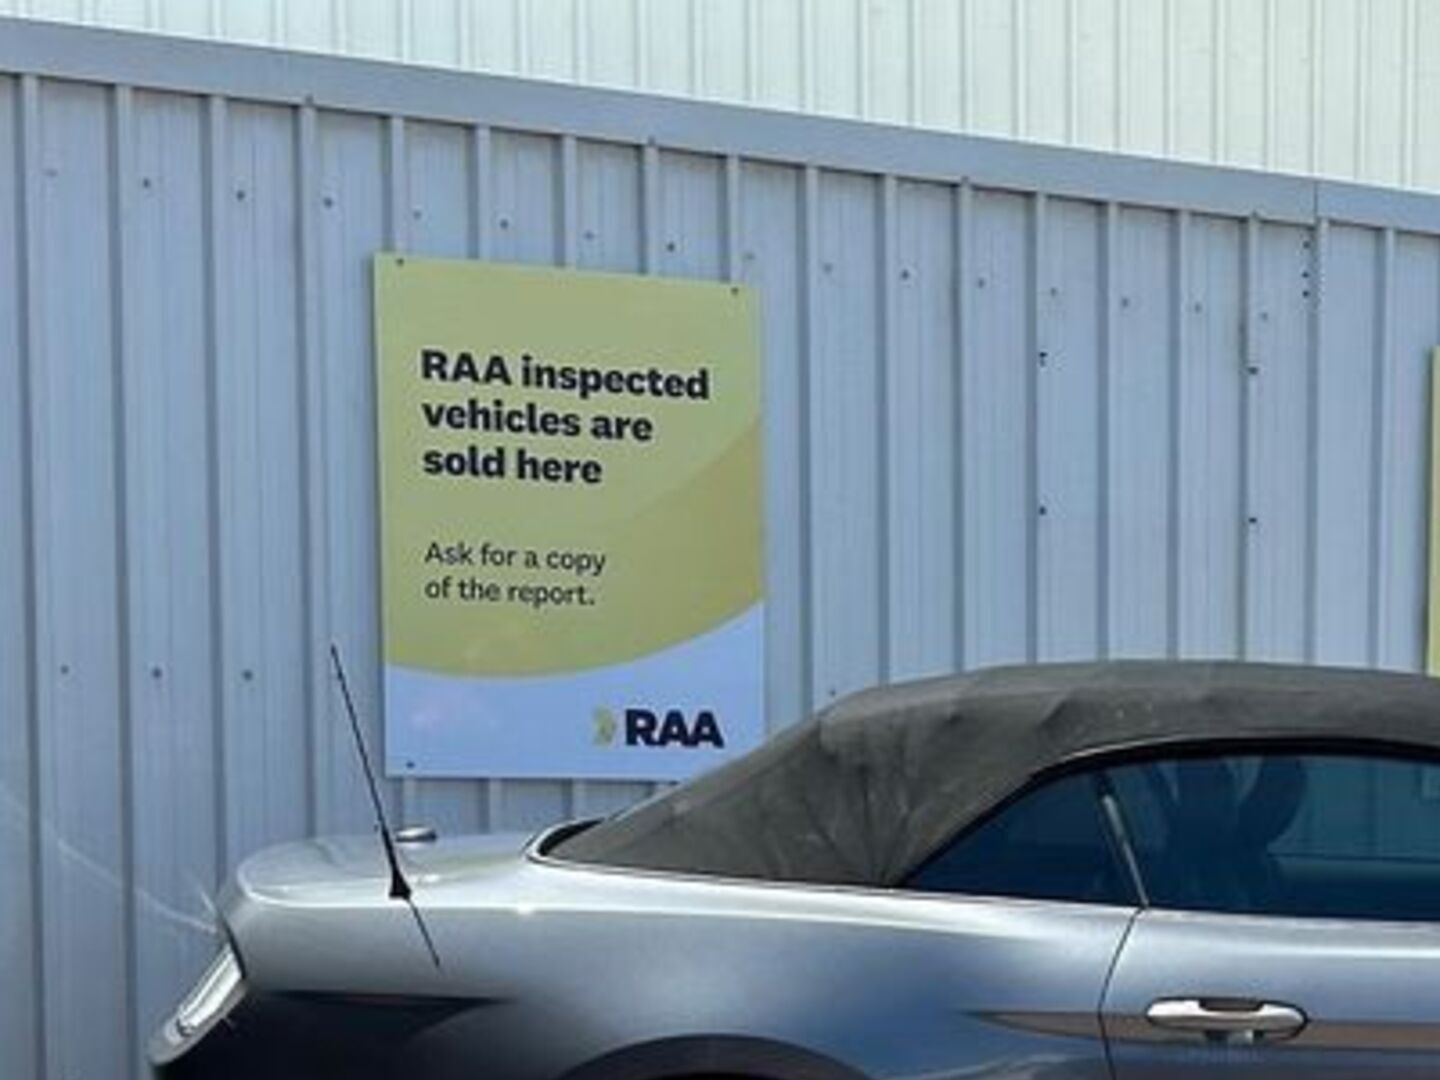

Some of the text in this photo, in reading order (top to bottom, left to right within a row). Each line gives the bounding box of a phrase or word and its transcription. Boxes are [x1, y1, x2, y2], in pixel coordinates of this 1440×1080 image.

[421, 350, 710, 400] RAA inspected
[422, 399, 654, 441] vehicles are
[423, 447, 603, 484] sold here
[424, 542, 607, 576] Ask for a copy
[424, 577, 596, 609] of the report.
[625, 709, 725, 748] RAA
